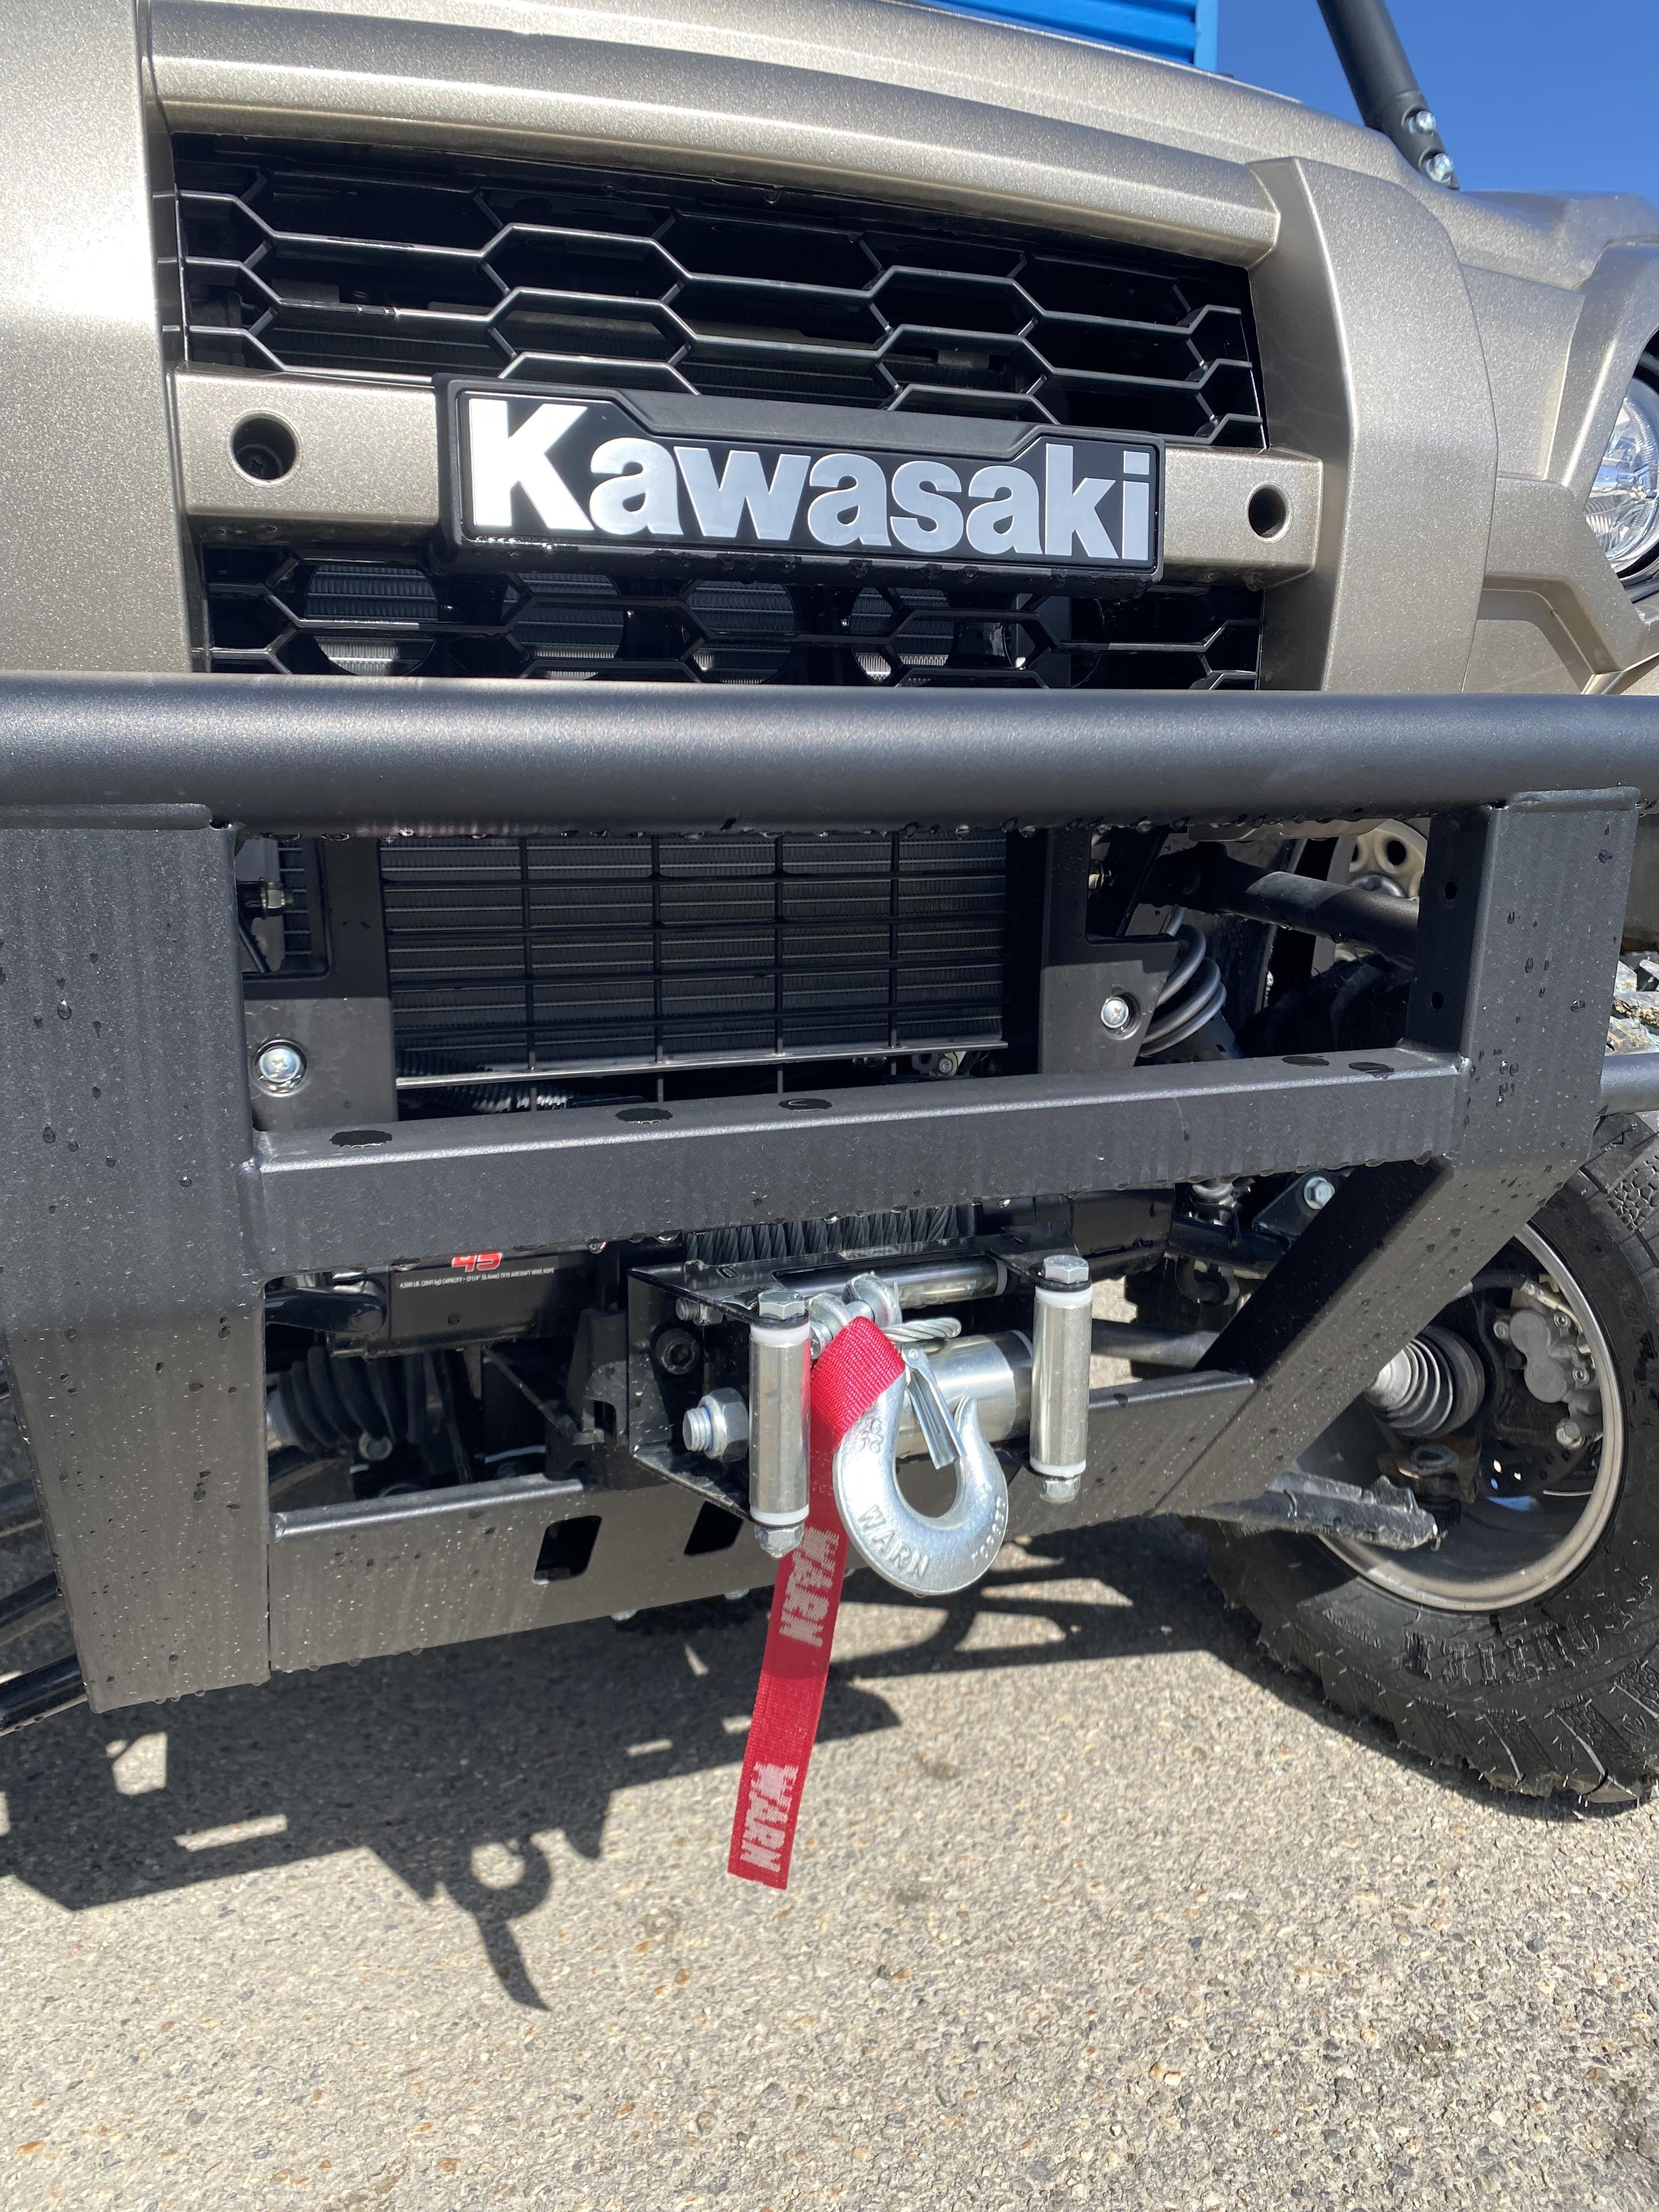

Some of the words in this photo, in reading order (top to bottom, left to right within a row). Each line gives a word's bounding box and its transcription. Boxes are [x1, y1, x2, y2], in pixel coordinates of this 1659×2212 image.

[469, 398, 1150, 562] Kawasaki
[779, 1525, 839, 1647] WARN
[858, 1504, 930, 1579] WARN
[740, 1761, 799, 1873] WARN
